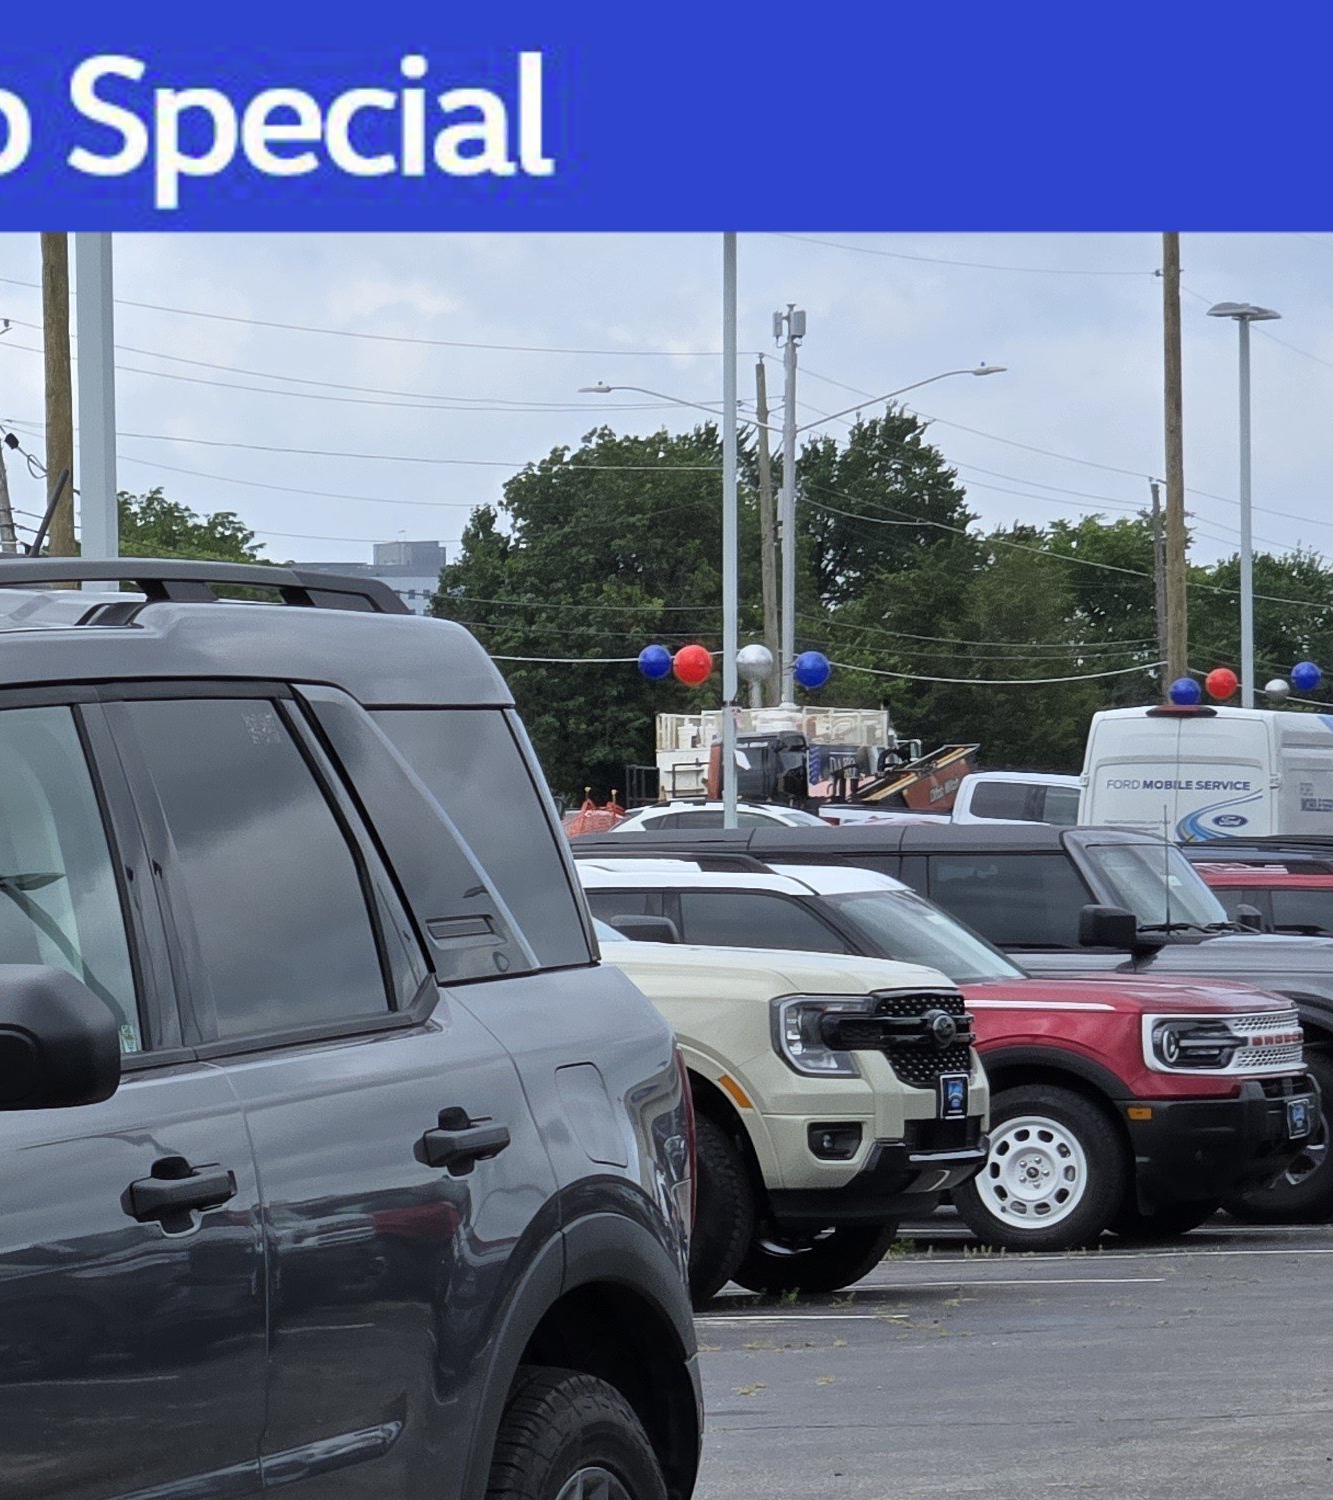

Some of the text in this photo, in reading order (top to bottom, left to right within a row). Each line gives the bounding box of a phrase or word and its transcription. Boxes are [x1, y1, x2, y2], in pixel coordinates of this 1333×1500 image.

[1106, 779, 1251, 791] FORD MOBILE SERVICE
